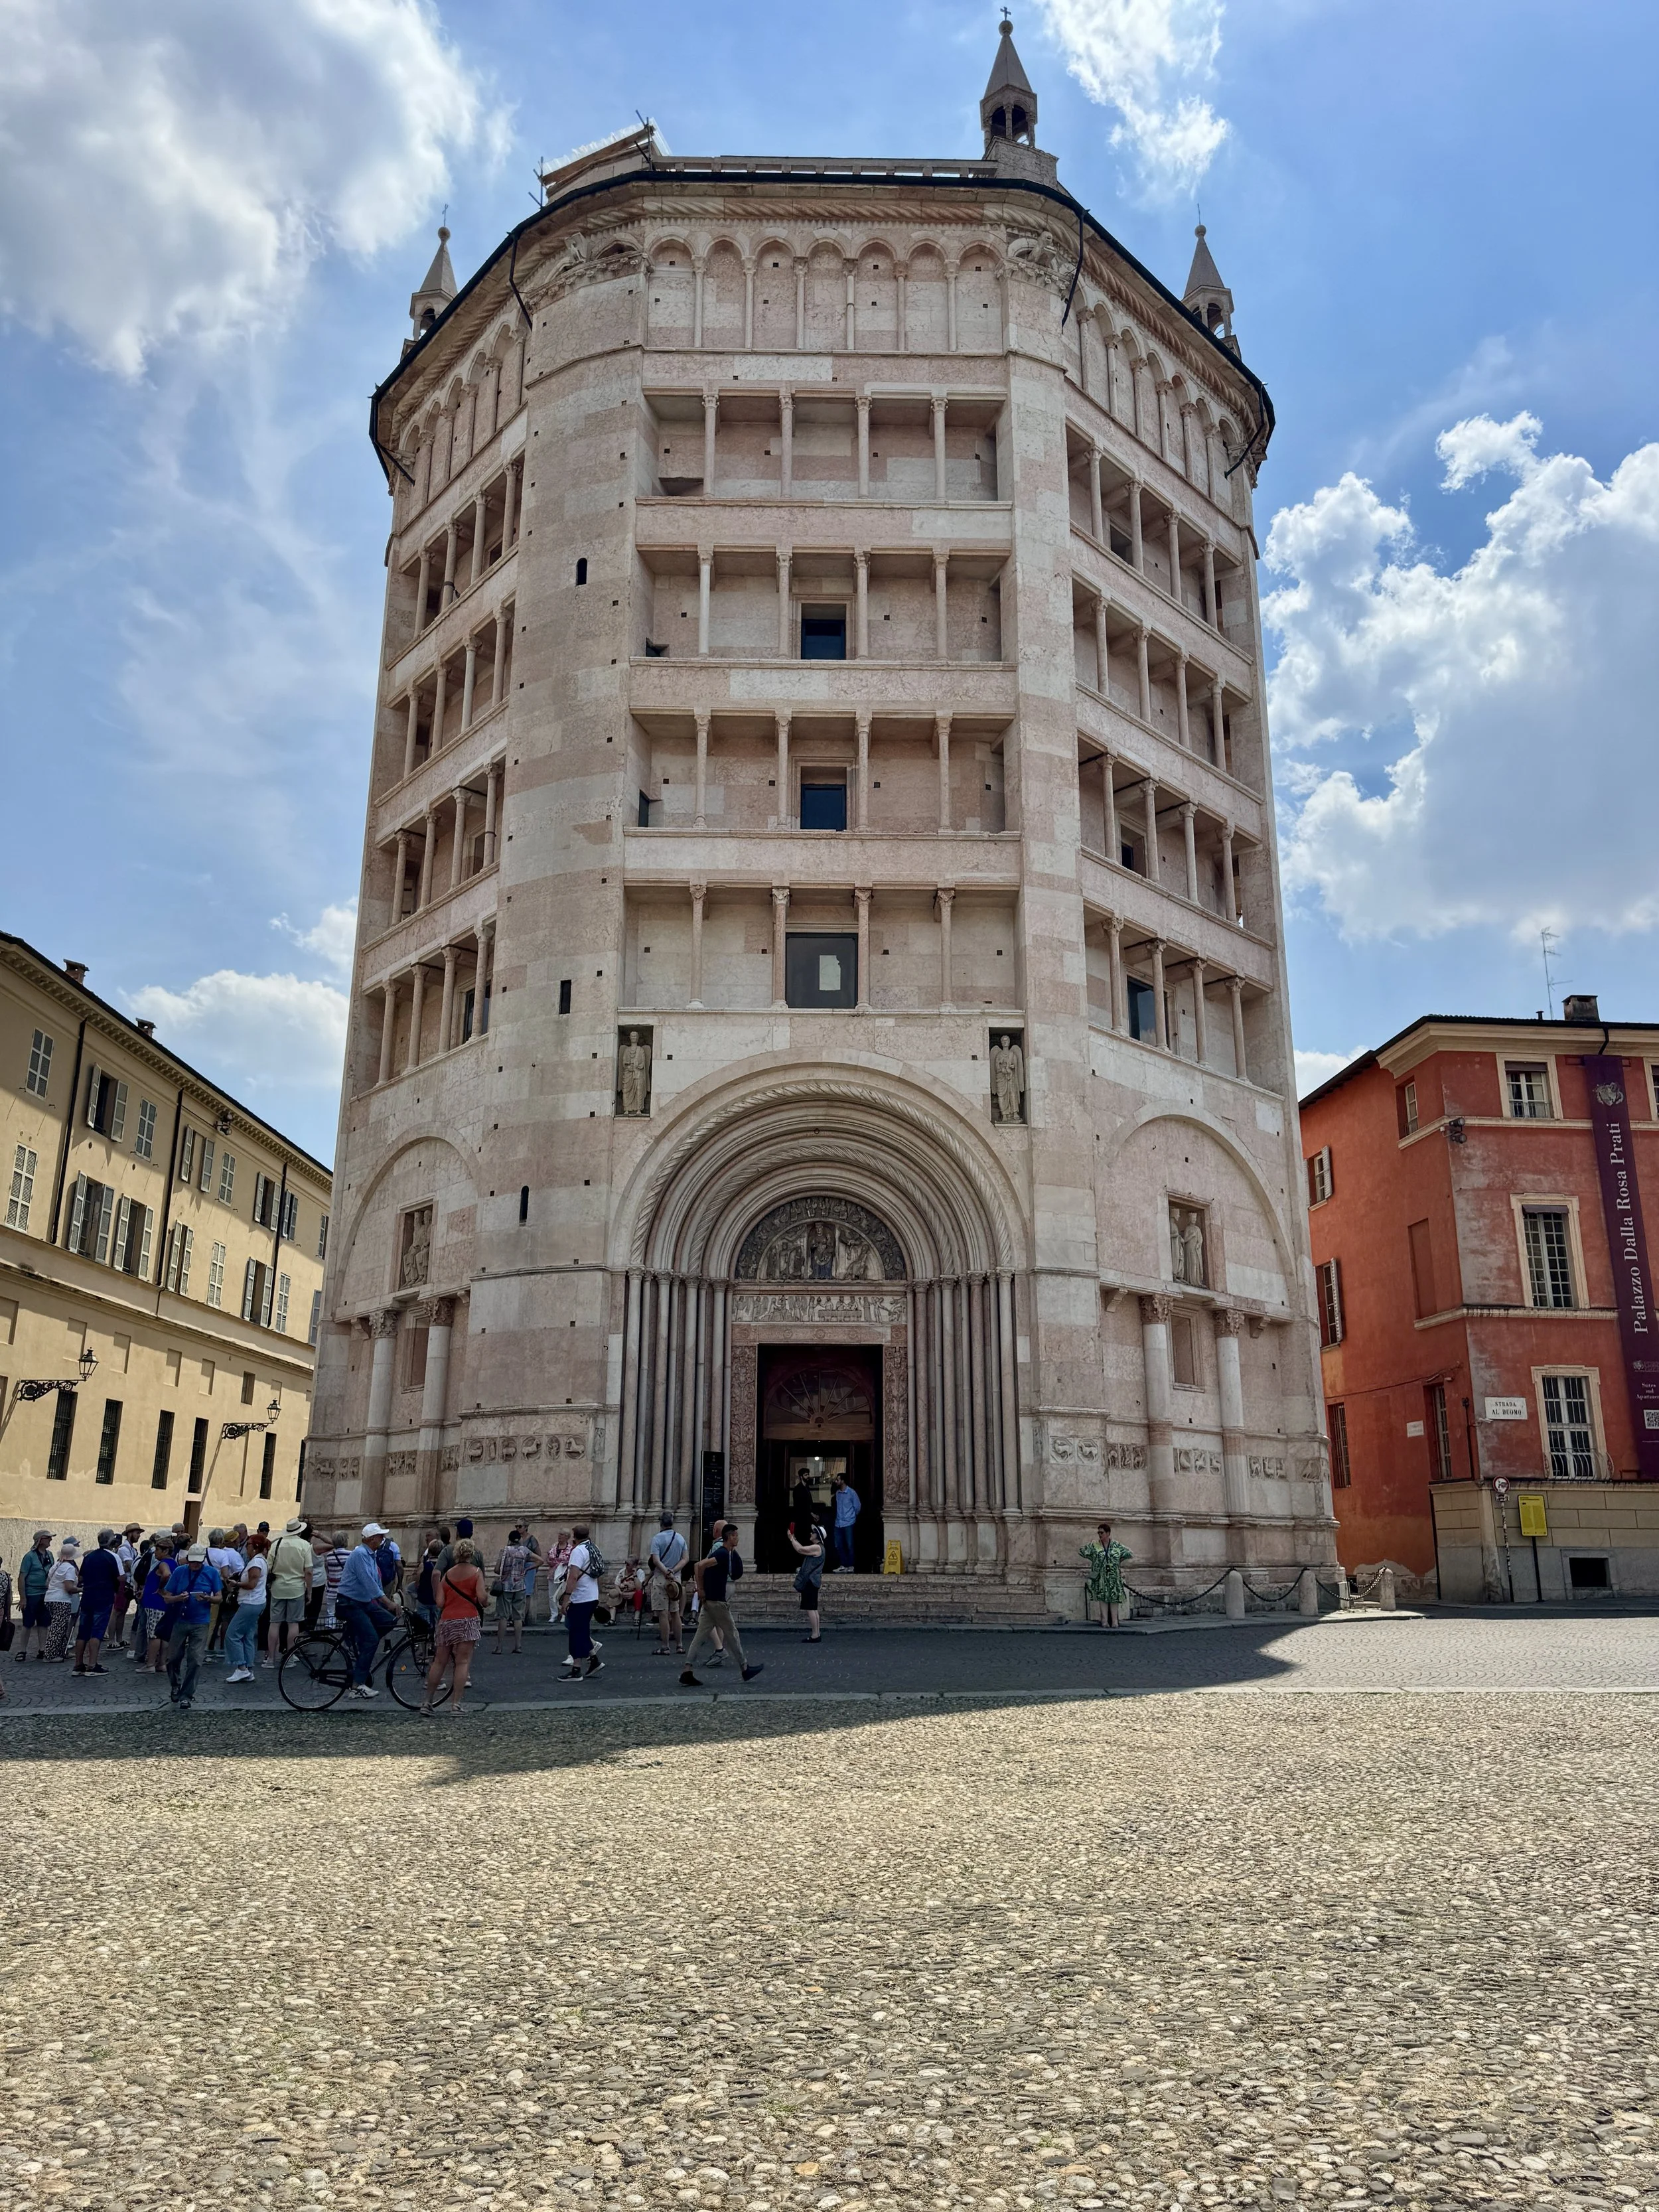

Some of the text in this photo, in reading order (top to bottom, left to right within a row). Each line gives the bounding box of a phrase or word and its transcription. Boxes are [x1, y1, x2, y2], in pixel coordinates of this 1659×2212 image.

[1606, 1122, 1649, 1334] Palazzo Dalla Rosa Prati
